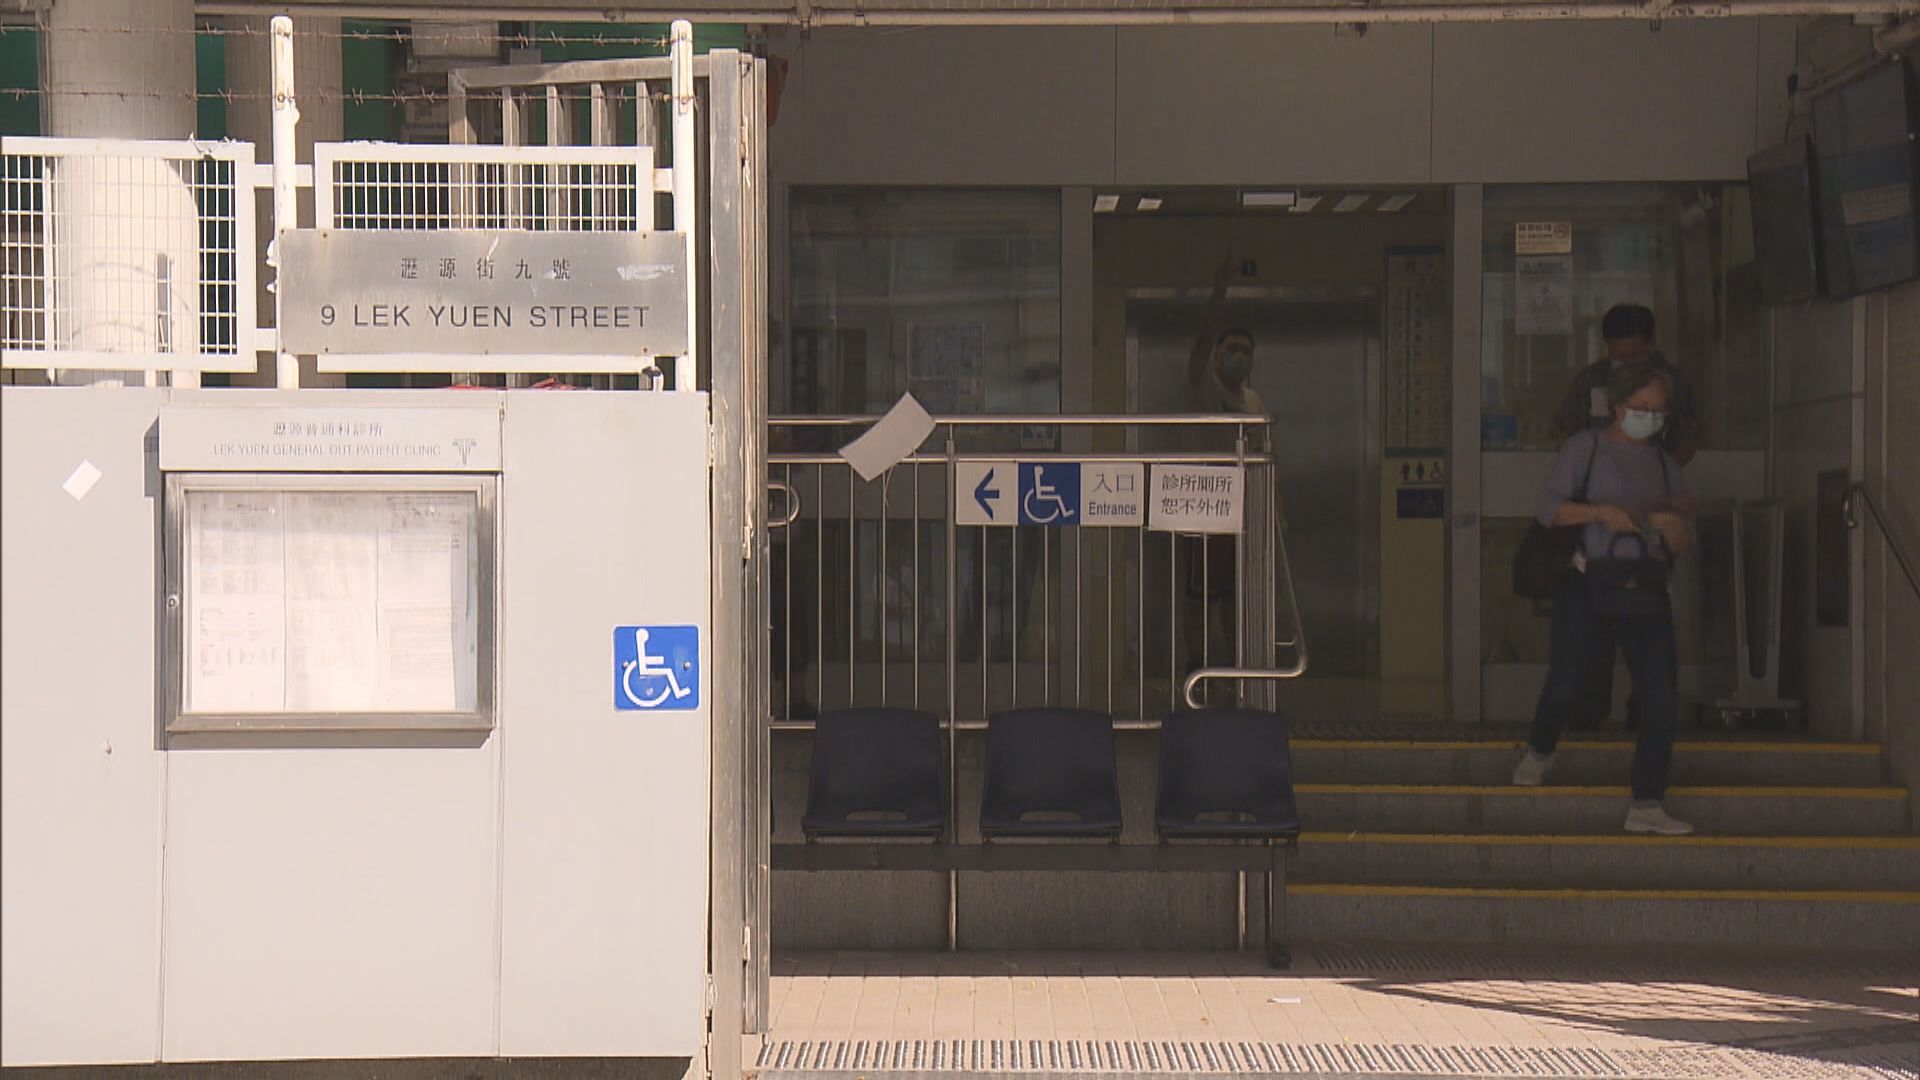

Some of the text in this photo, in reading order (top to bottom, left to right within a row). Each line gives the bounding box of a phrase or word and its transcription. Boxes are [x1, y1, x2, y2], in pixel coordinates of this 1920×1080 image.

[320, 304, 650, 328] 9 LEK YUEN STREET
[213, 442, 441, 457] LEK YUEN GENERAL OUT PATIENT CLINIC
[1091, 473, 1135, 493] 入口
[1088, 501, 1137, 516] Entrance
[1161, 497, 1231, 517] 恕不外借
